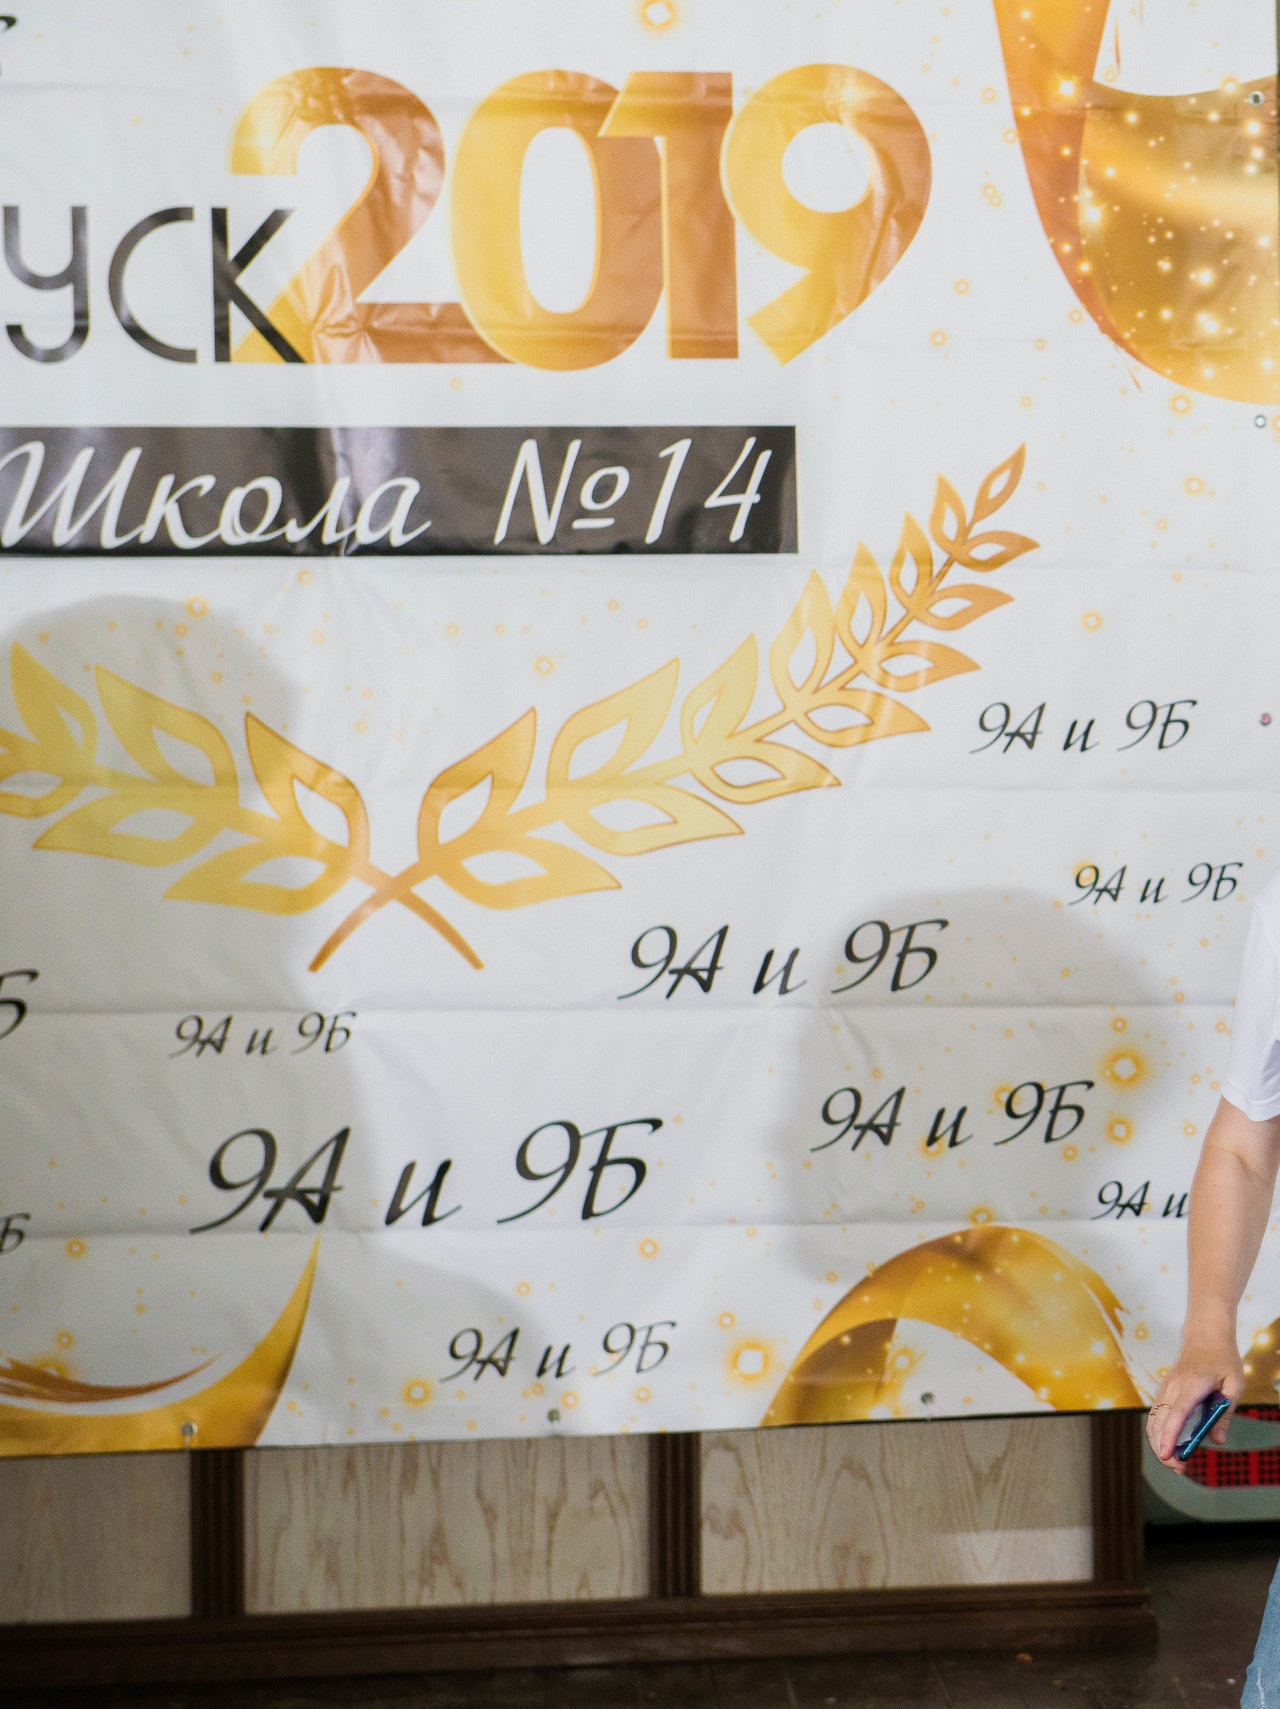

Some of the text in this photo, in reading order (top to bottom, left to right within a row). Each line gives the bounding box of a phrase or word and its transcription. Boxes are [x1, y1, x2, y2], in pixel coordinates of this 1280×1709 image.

[229, 65, 933, 371] 2019
[0, 440, 431, 550] Школа
[970, 699, 1198, 754] 9А и 9Б
[1069, 861, 1244, 905] 9А и 9Б
[617, 918, 950, 1001] 9А и 9Б
[168, 1011, 357, 1059] 9А и 9Б
[810, 1079, 1095, 1153] 9А и 9Б
[188, 1116, 664, 1236] 9А и 9Б
[1090, 1180, 1189, 1220] 9А и
[440, 1320, 678, 1383] 9А и 9Б
